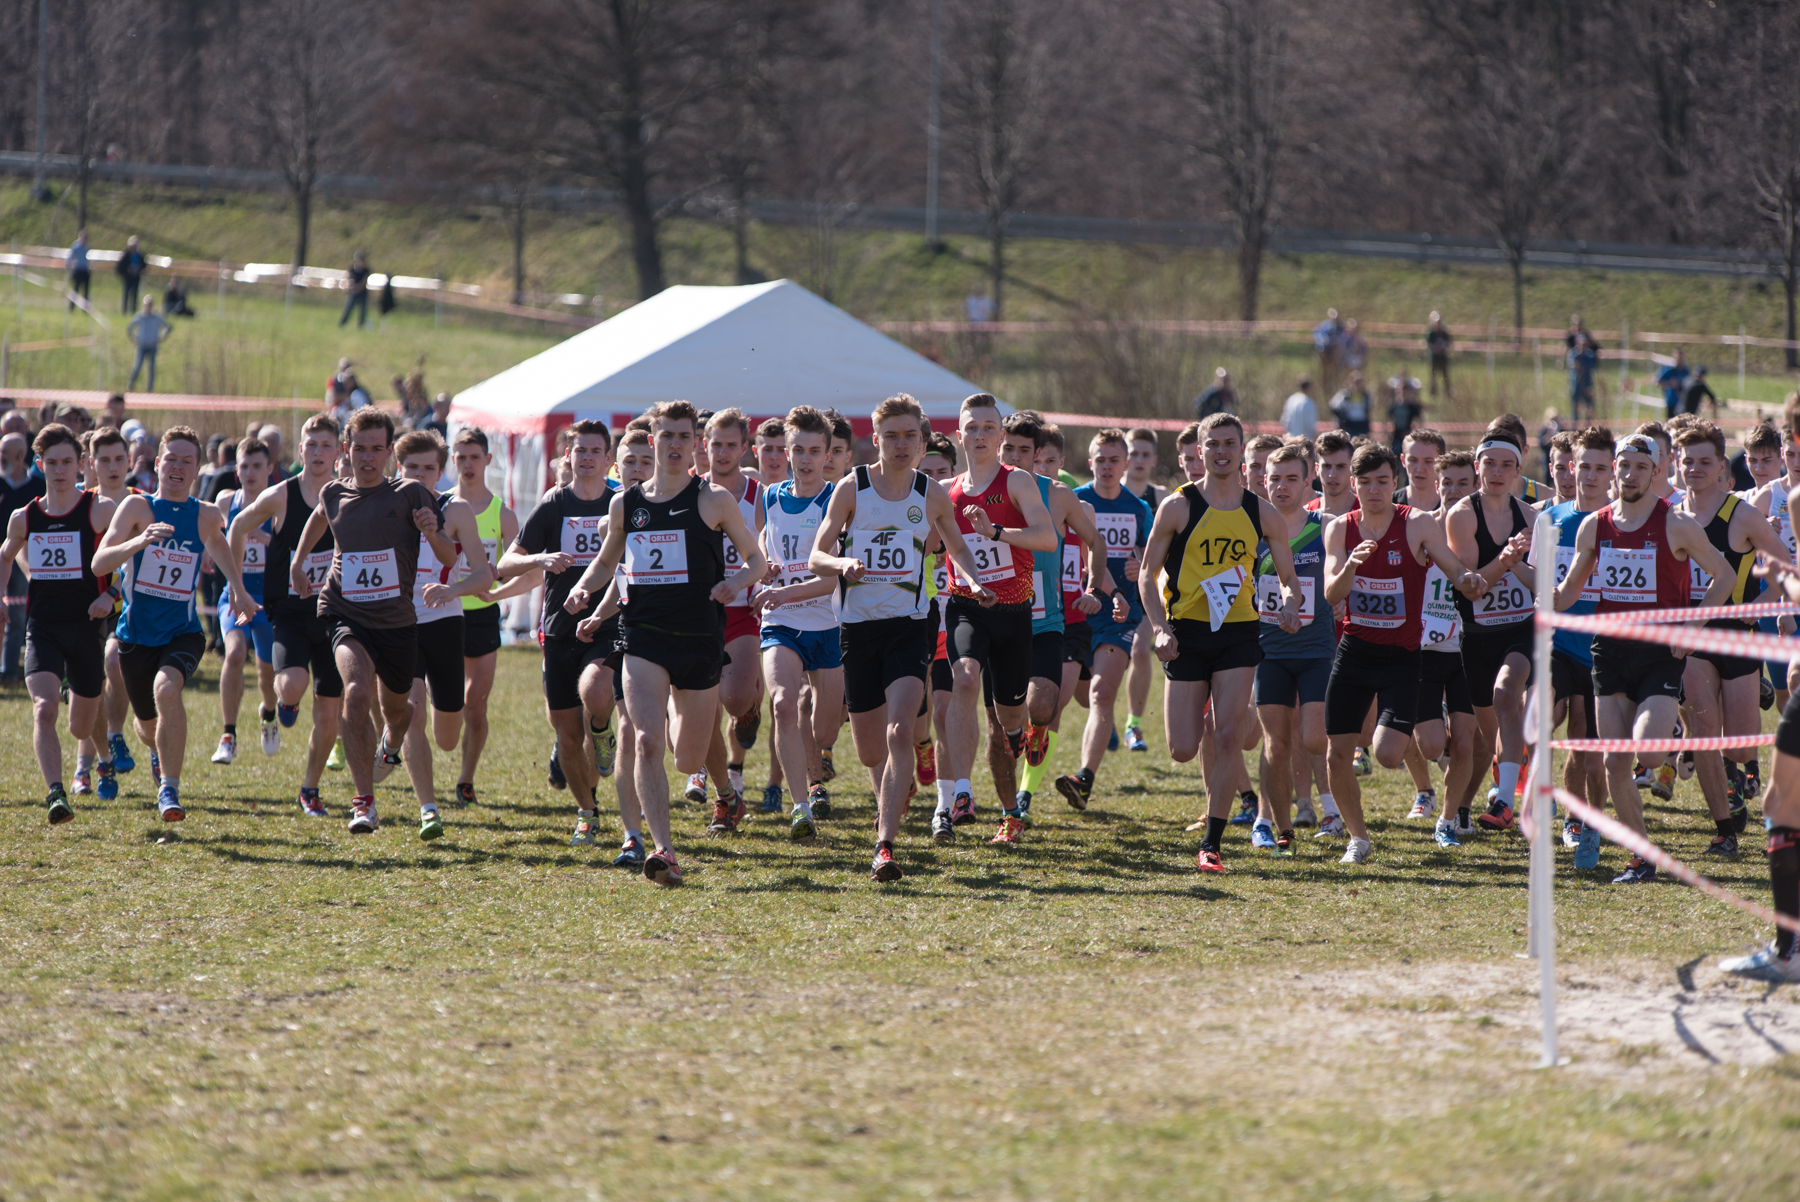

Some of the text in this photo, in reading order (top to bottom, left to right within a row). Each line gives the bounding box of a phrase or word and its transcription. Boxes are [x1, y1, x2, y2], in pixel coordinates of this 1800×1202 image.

[575, 533, 602, 553] 85
[782, 534, 799, 560] 37
[871, 532, 897, 545] 4F
[41, 548, 67, 567] 28
[169, 554, 191, 563] ORLEN
[363, 554, 388, 562] ORLEN
[649, 549, 664, 570] 2
[864, 548, 905, 569] 150
[1200, 538, 1246, 566] 179
[158, 565, 182, 586] 19
[356, 568, 383, 588] 46
[1605, 566, 1647, 588] 326
[145, 588, 167, 598] OLSZYNA
[1482, 588, 1524, 612] 250
[781, 603, 804, 611] OLSZYNA
[1357, 593, 1397, 615] 328
[1486, 617, 1509, 625] OLSZYNA
